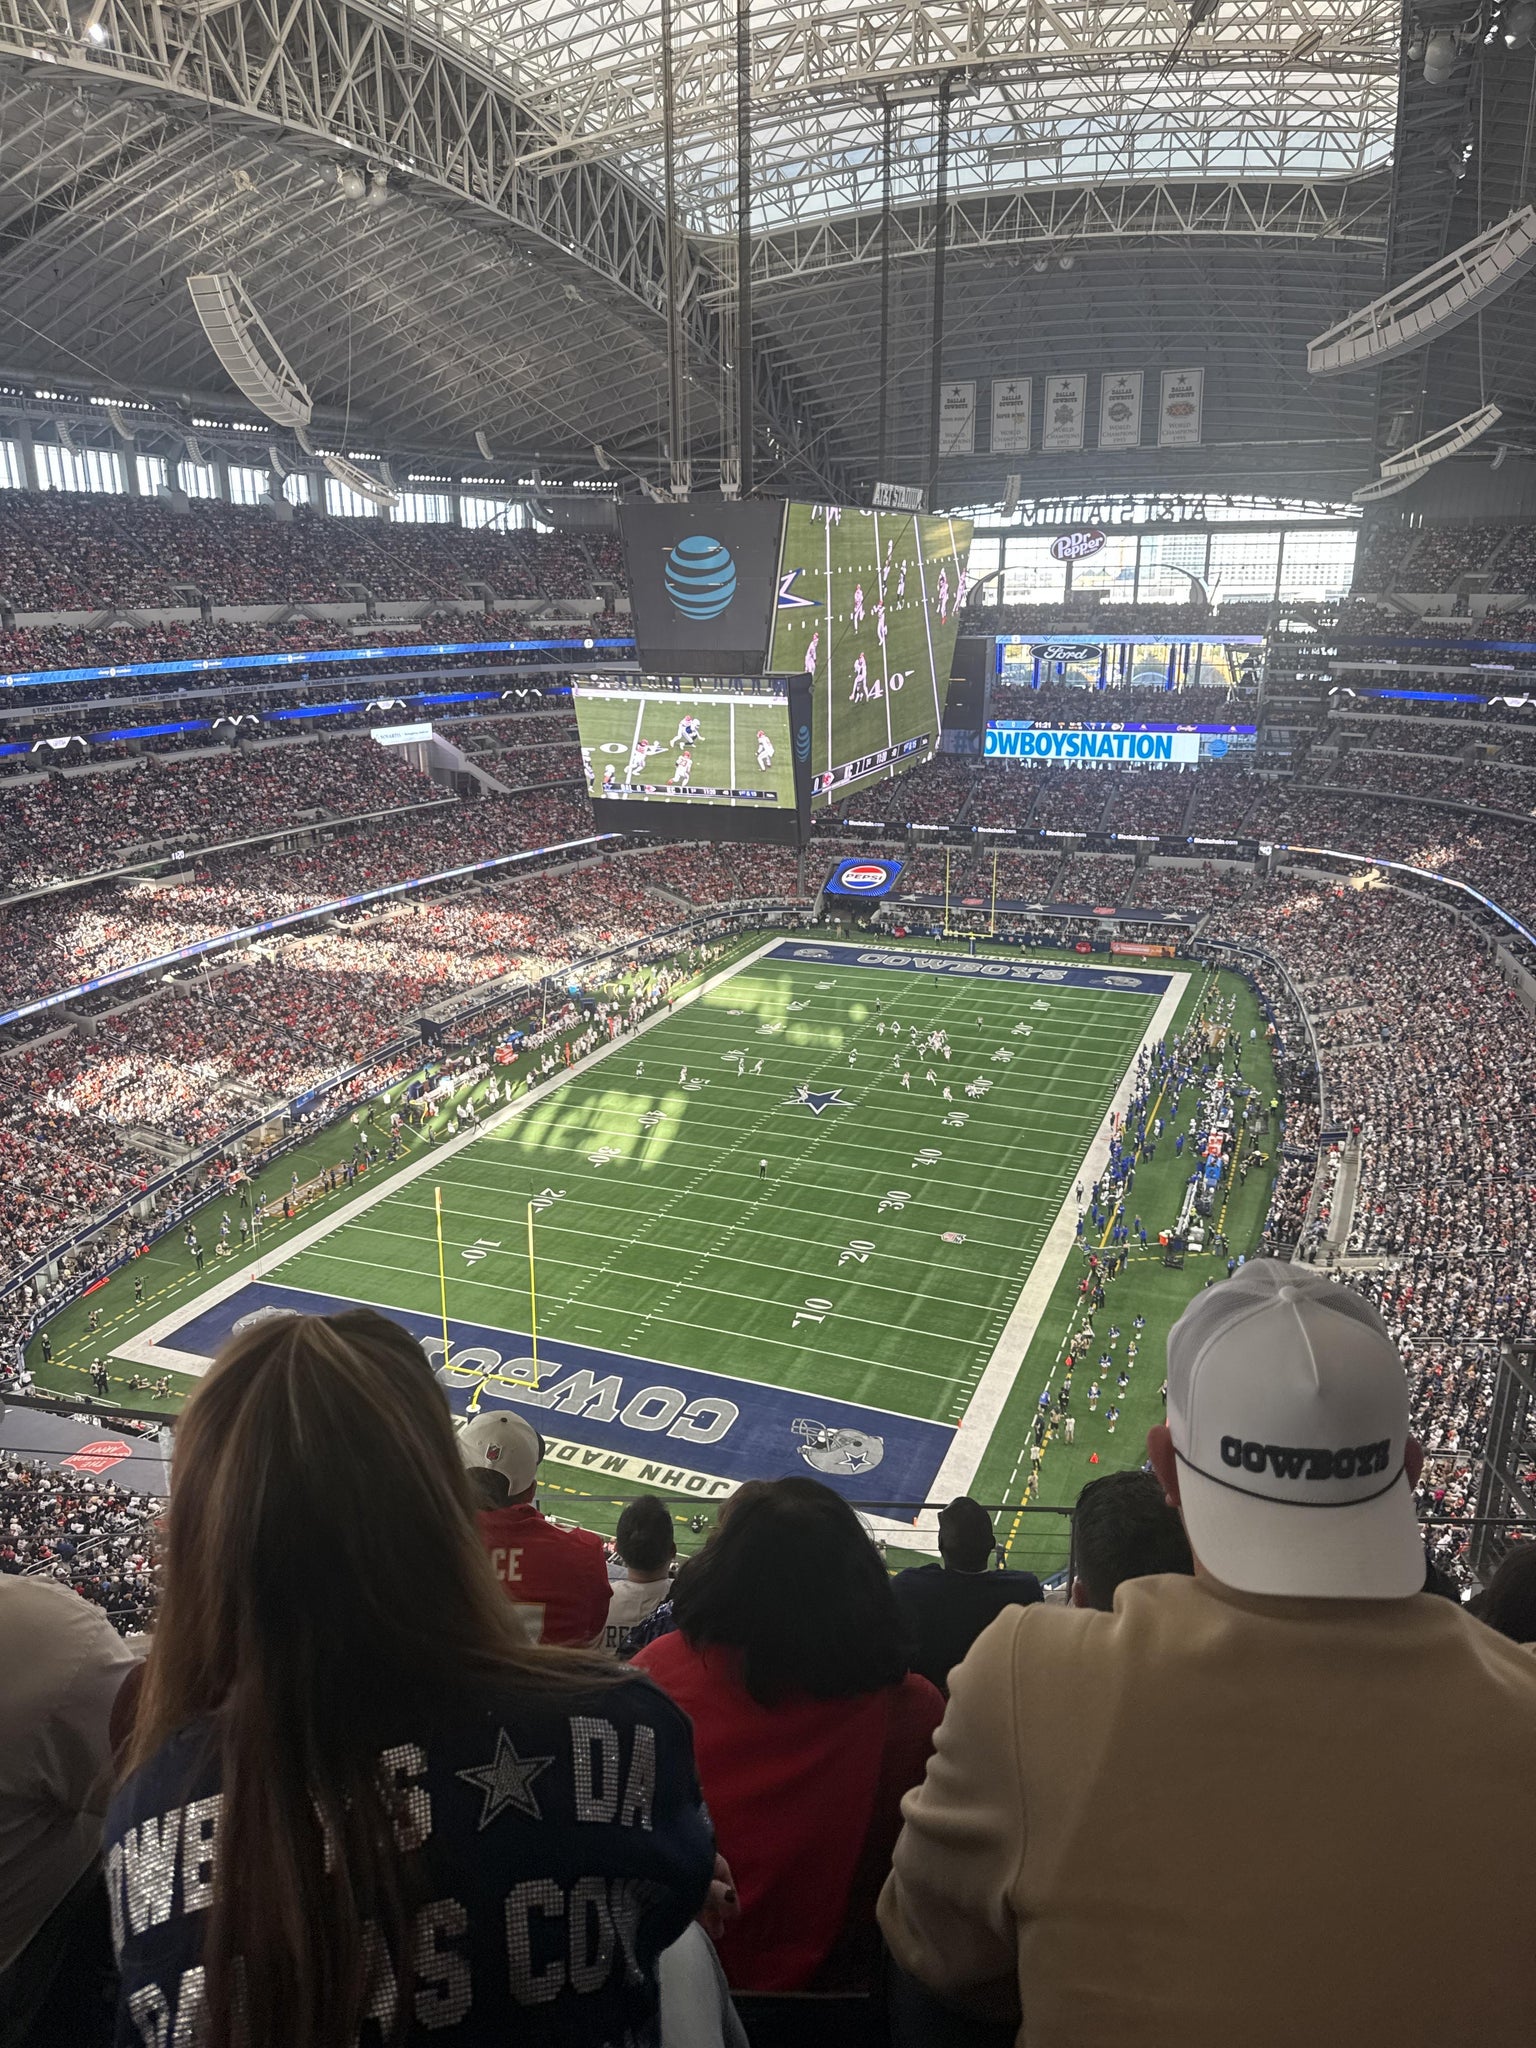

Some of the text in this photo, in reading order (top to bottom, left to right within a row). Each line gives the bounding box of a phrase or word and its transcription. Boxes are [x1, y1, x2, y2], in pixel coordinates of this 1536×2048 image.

[872, 482, 893, 506] AT&T
[1057, 537, 1104, 559] Pepper
[1070, 531, 1091, 546] Dr
[1043, 645, 1088, 660] Ford
[868, 672, 905, 699] 40
[846, 873, 883, 881] PEPSI
[859, 944, 896, 952] JOHN
[903, 948, 965, 958] MADDEN
[857, 953, 1068, 980] COWBOYS
[588, 1146, 622, 1163] 30
[914, 1149, 943, 1165] 40
[530, 1188, 567, 1207] 20
[879, 1191, 911, 1210] 30
[461, 1239, 501, 1259] 10
[840, 1240, 876, 1263] 20
[796, 1298, 833, 1324] 10
[1220, 1435, 1391, 1480] COWBOYS
[640, 1463, 730, 1496] JOHN
